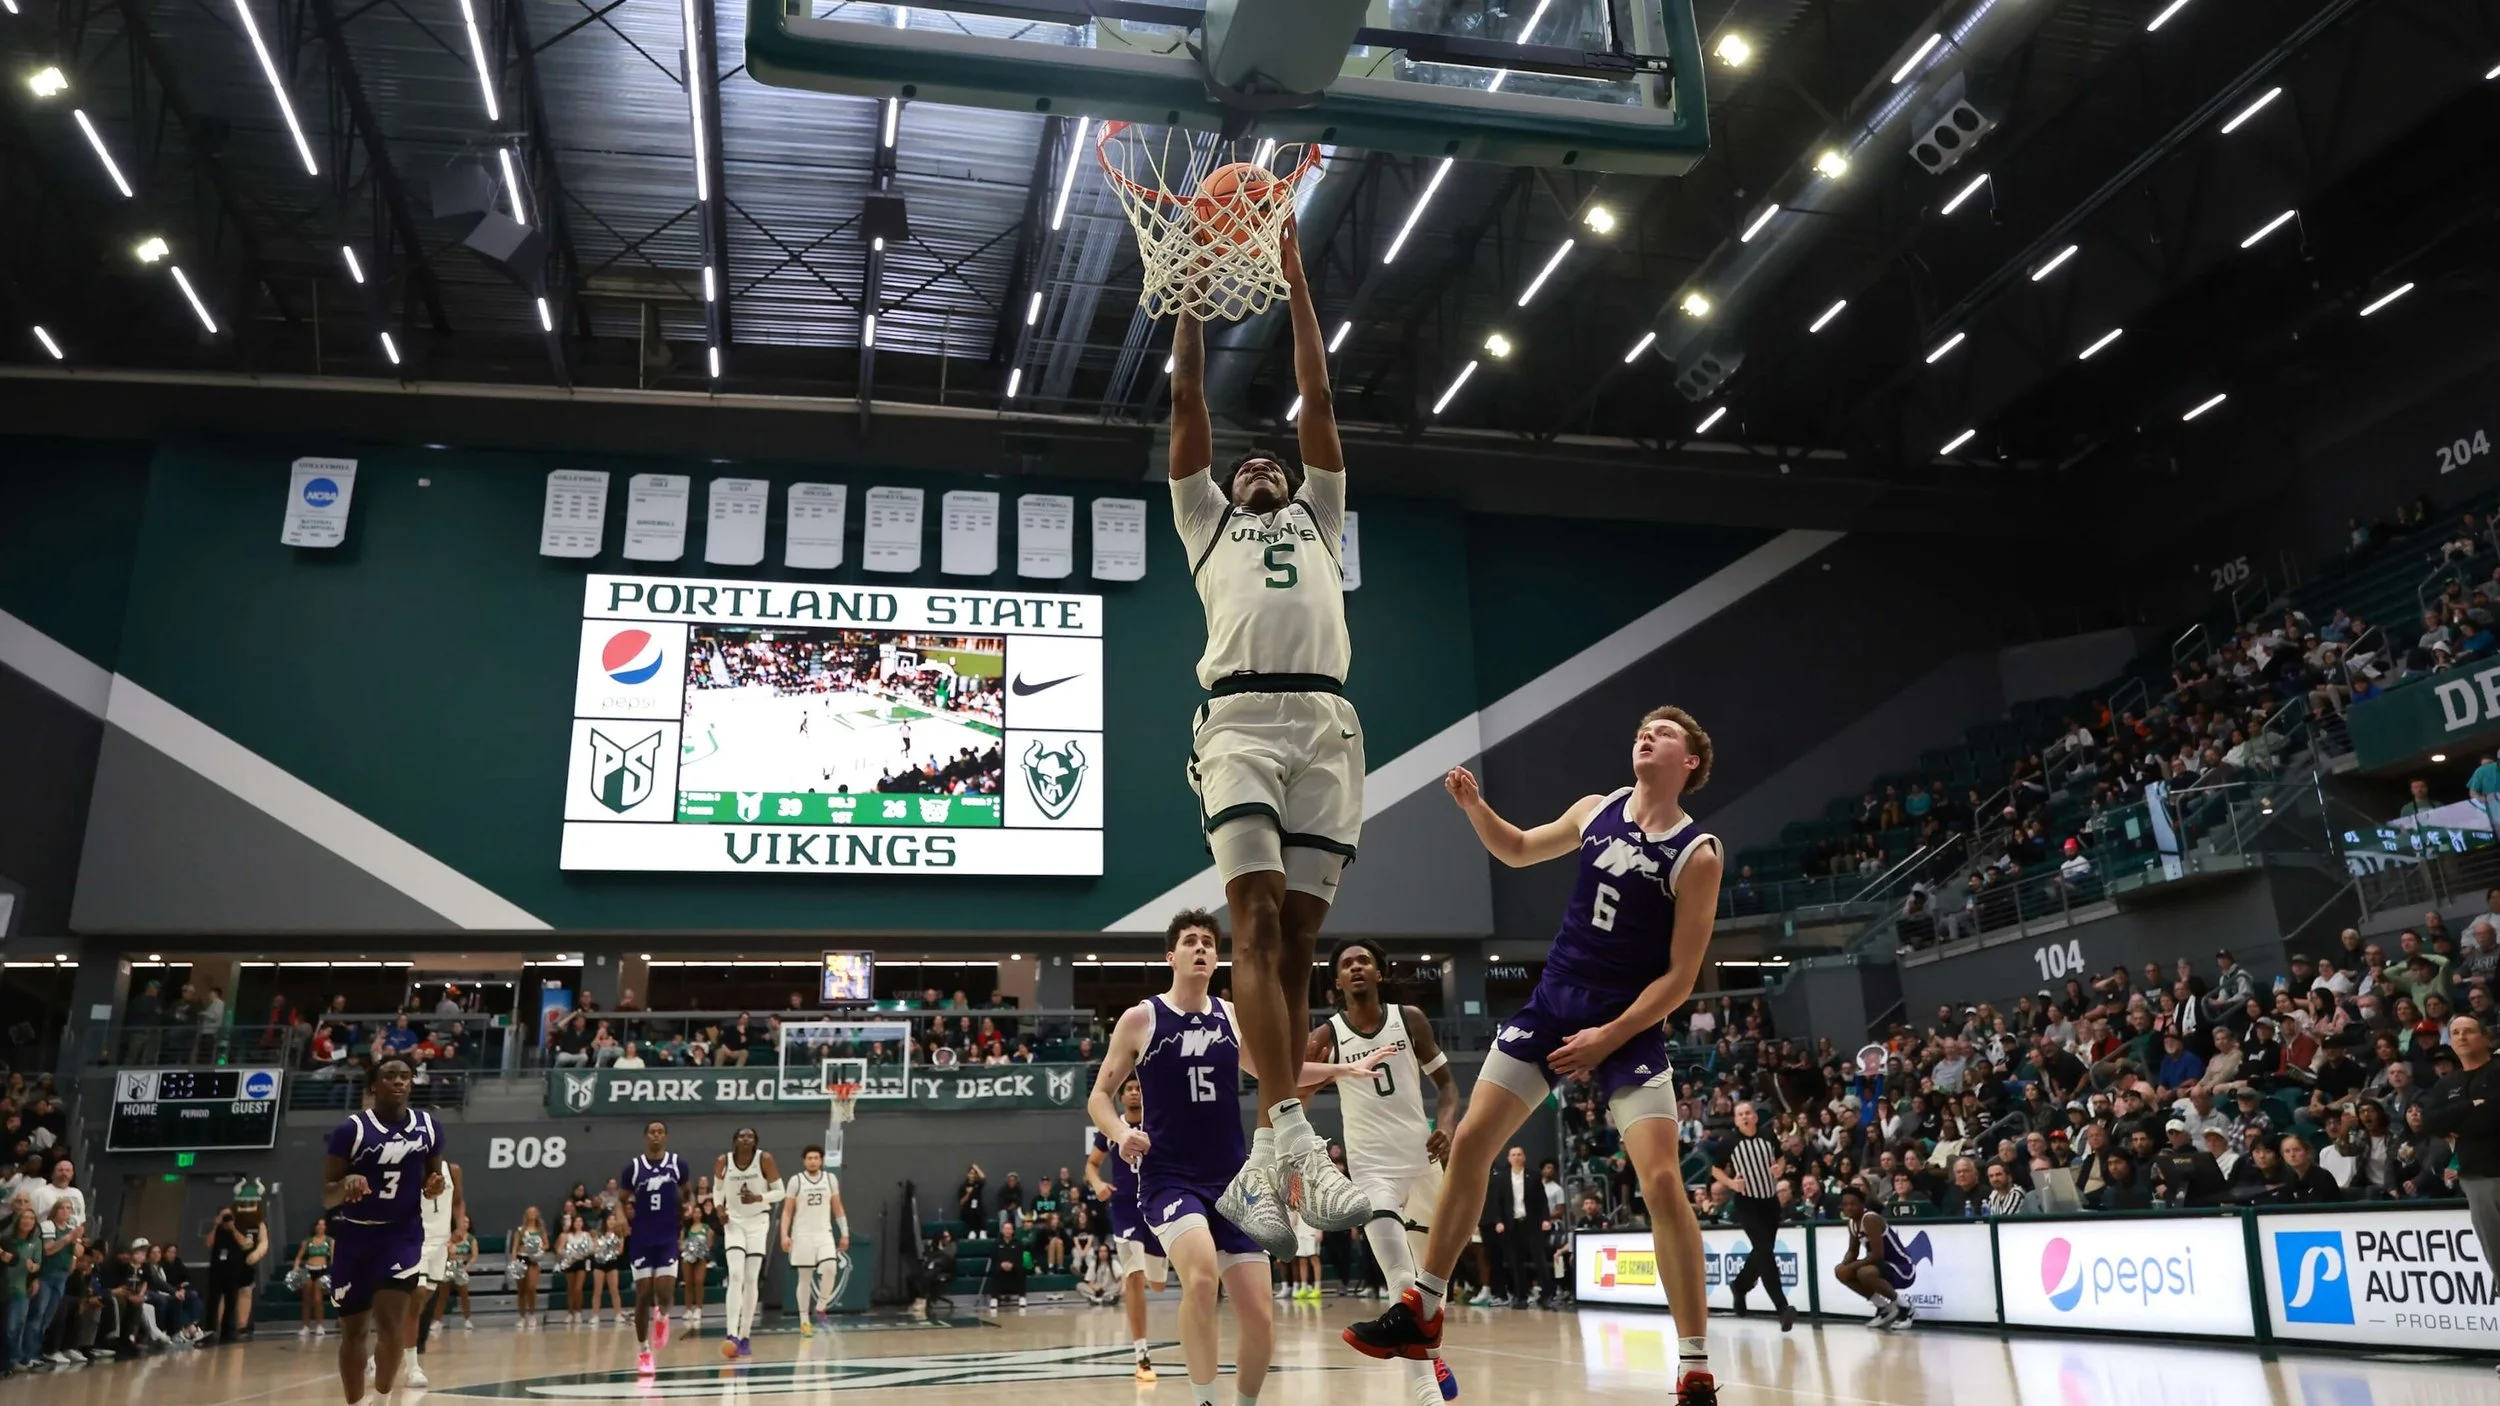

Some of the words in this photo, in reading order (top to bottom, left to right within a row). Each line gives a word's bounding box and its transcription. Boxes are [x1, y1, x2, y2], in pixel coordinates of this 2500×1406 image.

[2436, 429, 2491, 474] 204
[1264, 543, 1298, 589] 5
[2210, 556, 2250, 592] 205
[607, 582, 898, 623] PORTLAND
[926, 595, 1083, 630] STATE
[601, 694, 657, 711] pepsi
[724, 832, 957, 867] VIKINGS
[1591, 882, 1621, 932] 6
[2034, 938, 2086, 981] 104
[608, 1078, 704, 1102] PARK
[956, 1075, 1034, 1099] DECK
[1187, 1066, 1217, 1102] 15
[1371, 1062, 1396, 1097] 0
[122, 1103, 158, 1117] HOME
[180, 1109, 210, 1119] PERIOD
[231, 1102, 270, 1115] GUEST
[488, 1135, 567, 1169] B08
[379, 1171, 401, 1200] 3
[650, 1193, 662, 1211] 9
[807, 1193, 822, 1206] 23
[2355, 1229, 2479, 1263] PACIFIC
[1775, 1255, 1797, 1275] Point
[2092, 1245, 2195, 1306] pepsi
[2395, 1313, 2499, 1332] PROBLEM
